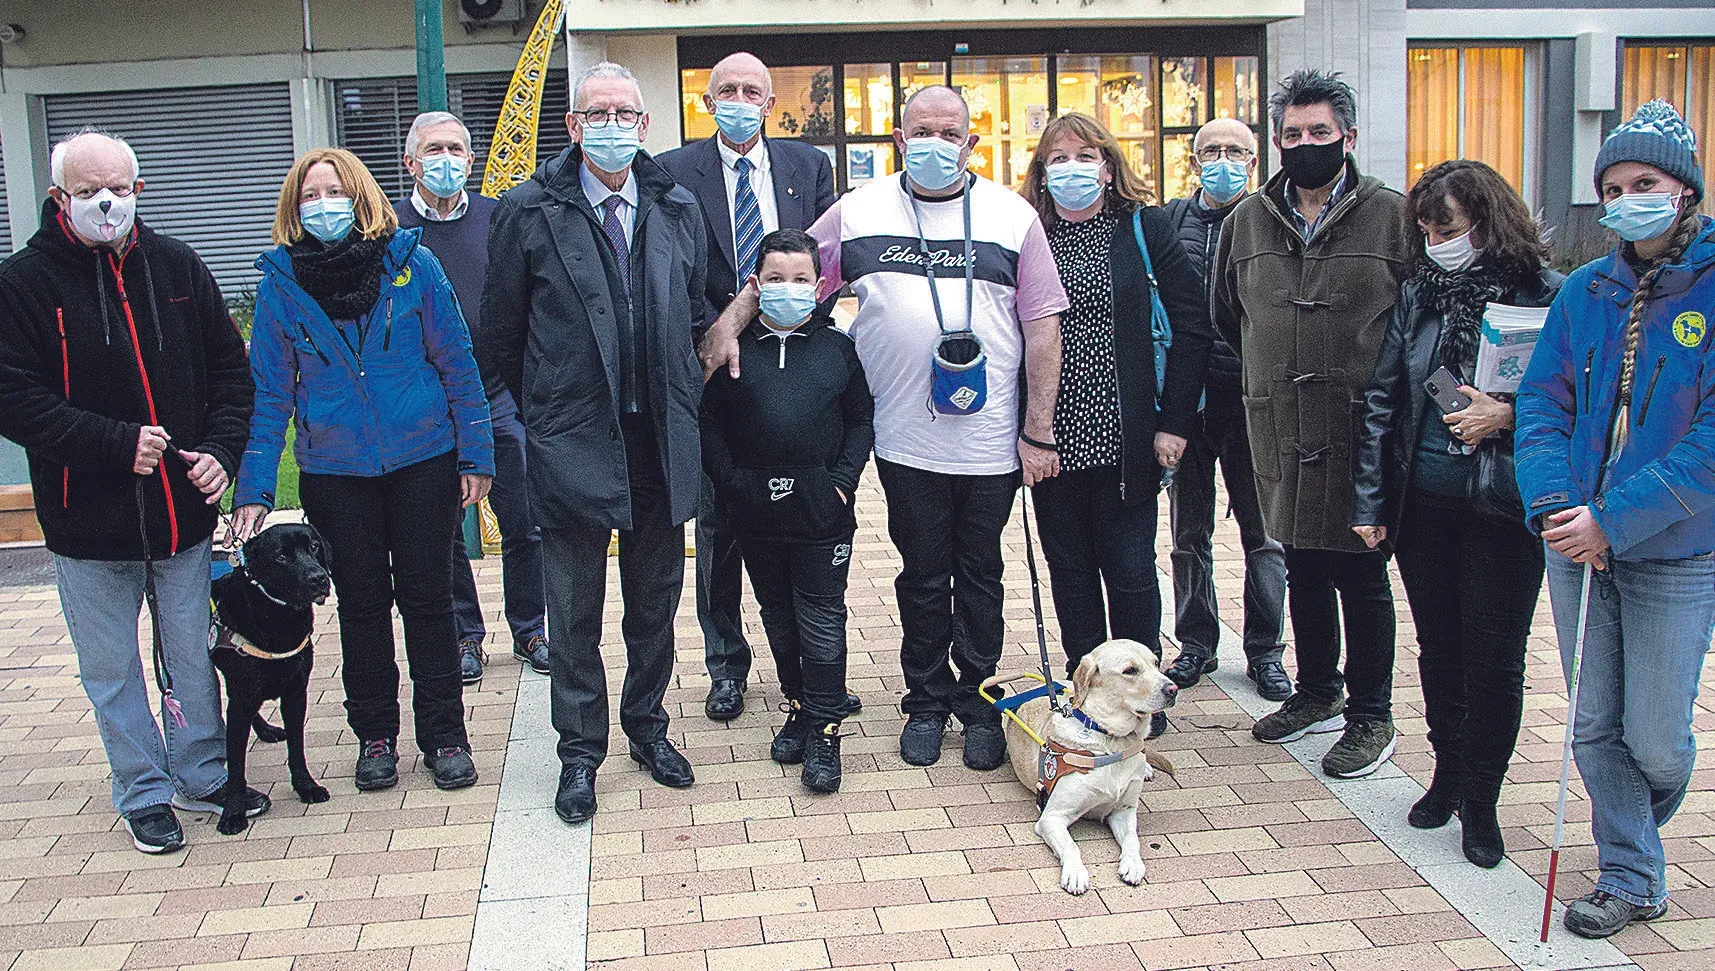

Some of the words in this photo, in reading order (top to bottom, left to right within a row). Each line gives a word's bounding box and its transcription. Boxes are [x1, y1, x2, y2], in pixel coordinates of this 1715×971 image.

[878, 245, 924, 265] Eden
[768, 478, 795, 491] CR7
[833, 543, 850, 556] CR7
